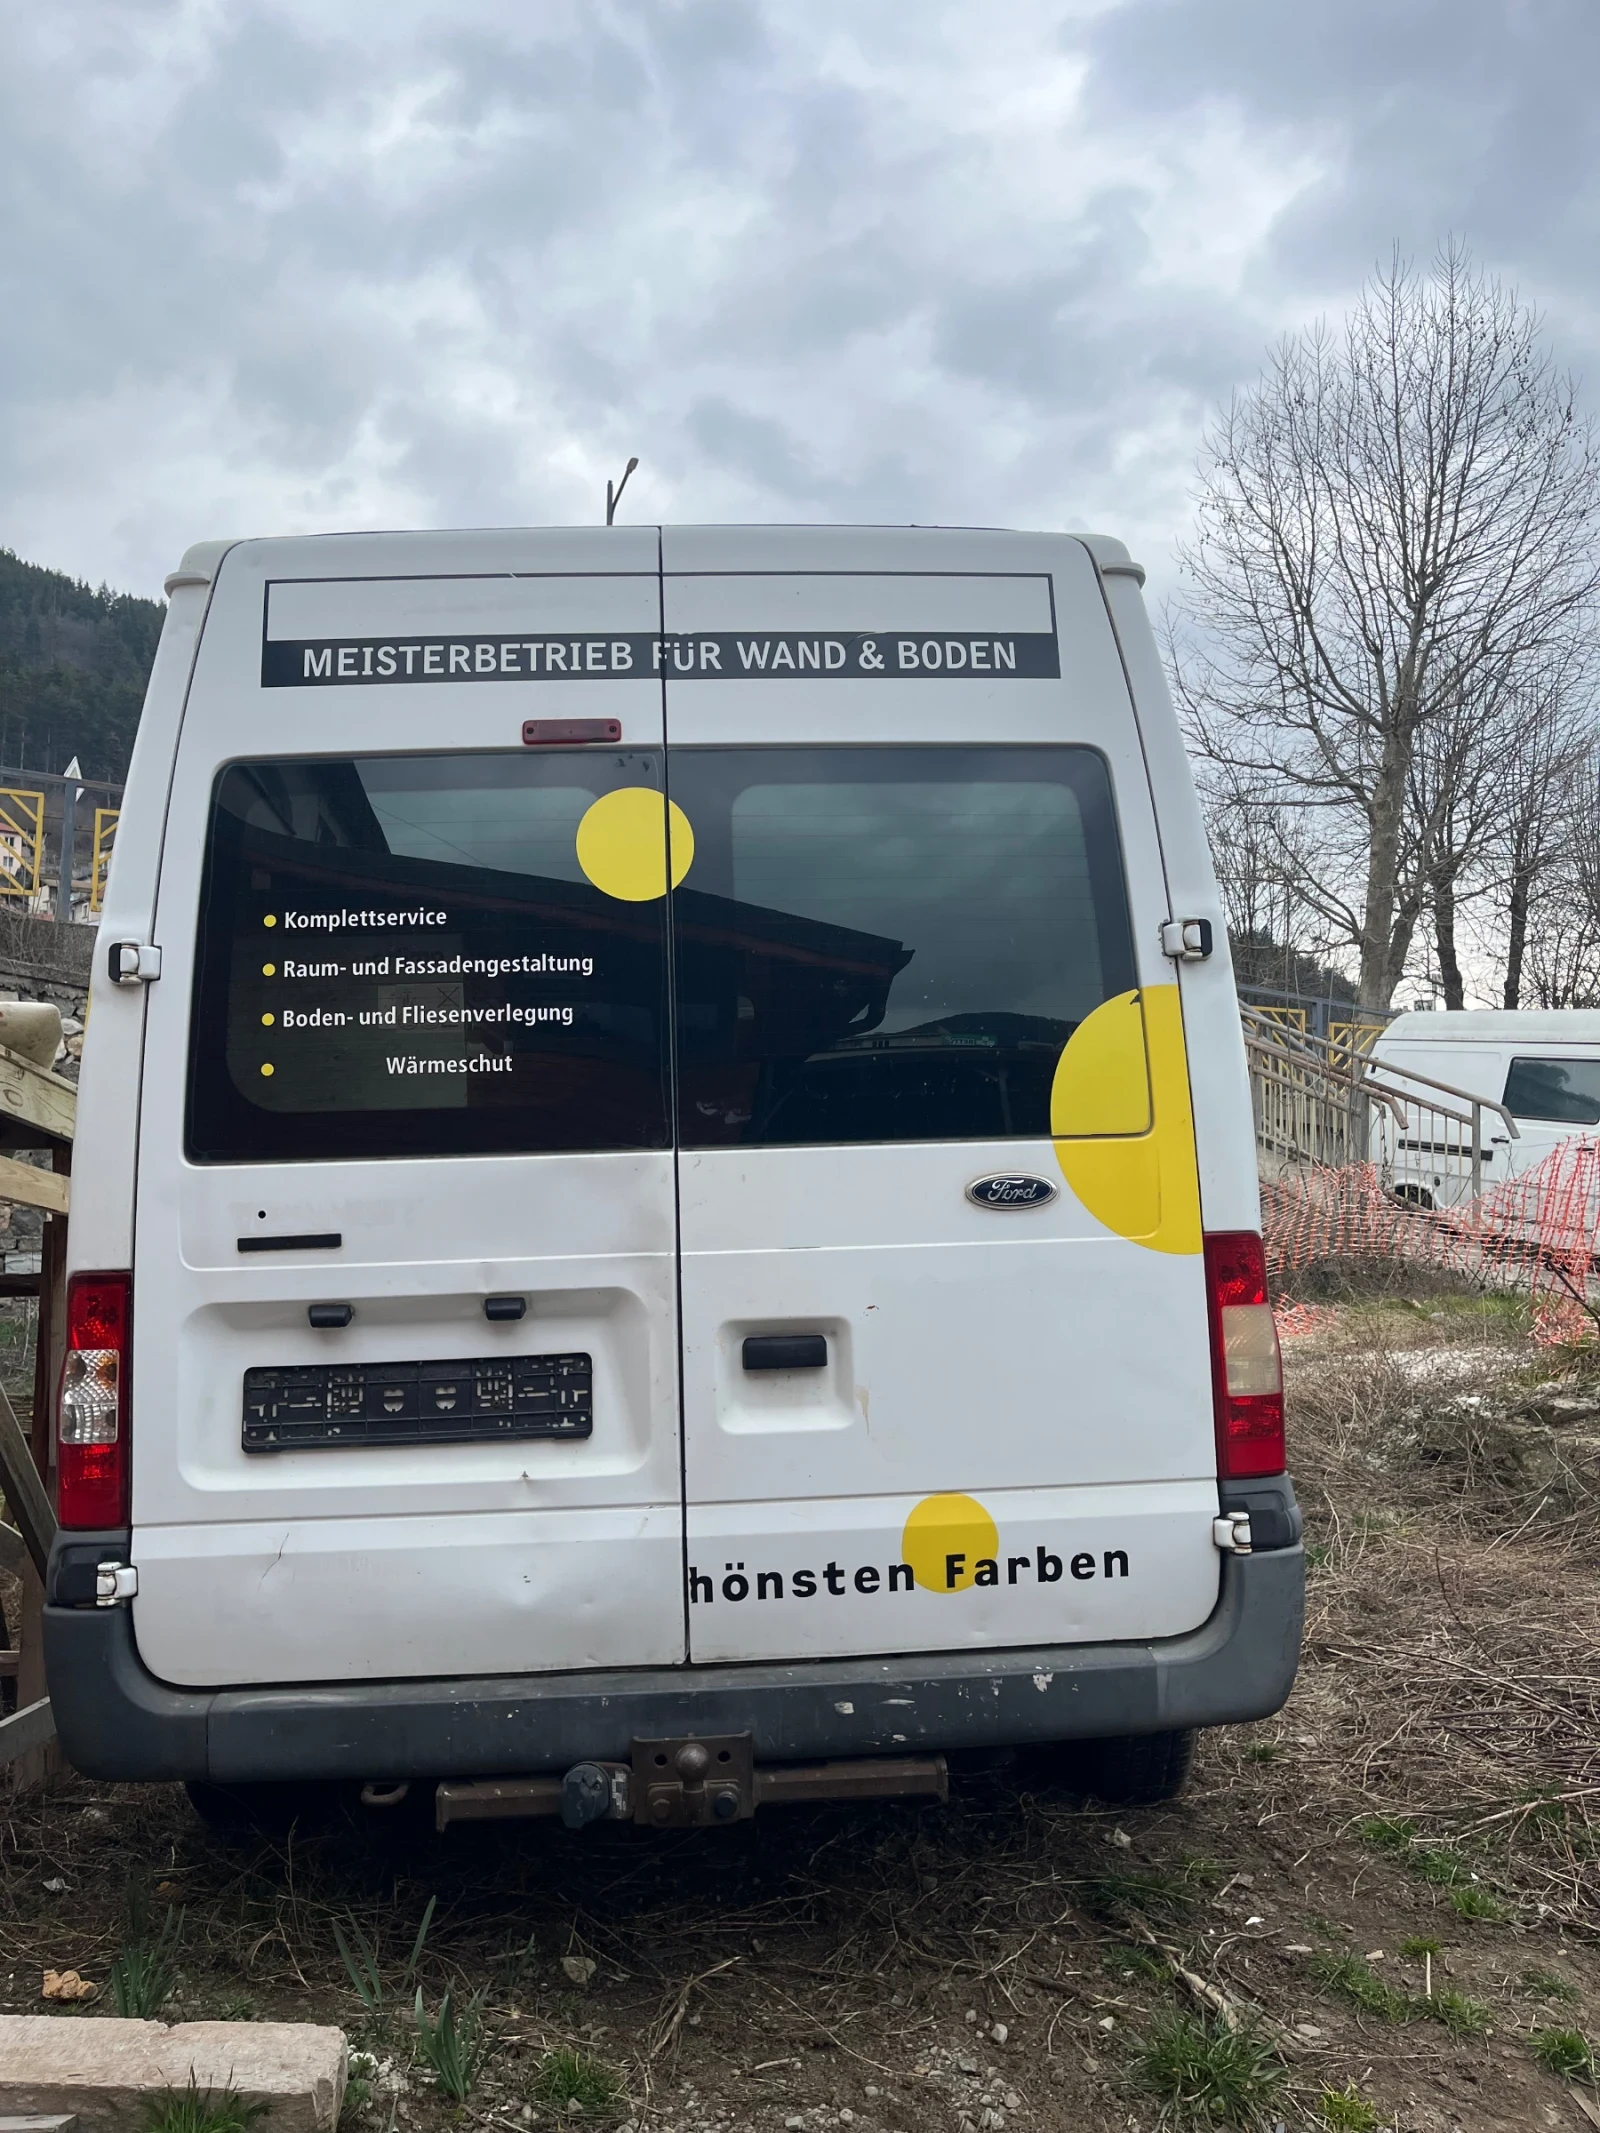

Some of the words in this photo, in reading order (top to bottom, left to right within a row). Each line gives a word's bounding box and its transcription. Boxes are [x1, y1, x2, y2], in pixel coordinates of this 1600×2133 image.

[303, 642, 632, 677] MEISTERBETRIEB
[652, 641, 722, 671] FÜR
[736, 641, 847, 669] WAND
[859, 641, 885, 669] &
[898, 641, 1016, 669] BODEN
[285, 907, 447, 932] Komplettservice
[284, 961, 347, 978] Raum-
[353, 957, 389, 976] und
[396, 954, 593, 978] Fassadengestaltung
[283, 1008, 354, 1028] Boden-
[359, 1006, 397, 1026] und
[403, 1004, 573, 1027] Fliesenverlegung
[387, 1054, 513, 1075] Wärmeschut
[987, 1179, 1038, 1201] Ford
[689, 1561, 915, 1603] hönsten
[946, 1547, 1129, 1589] Farben
